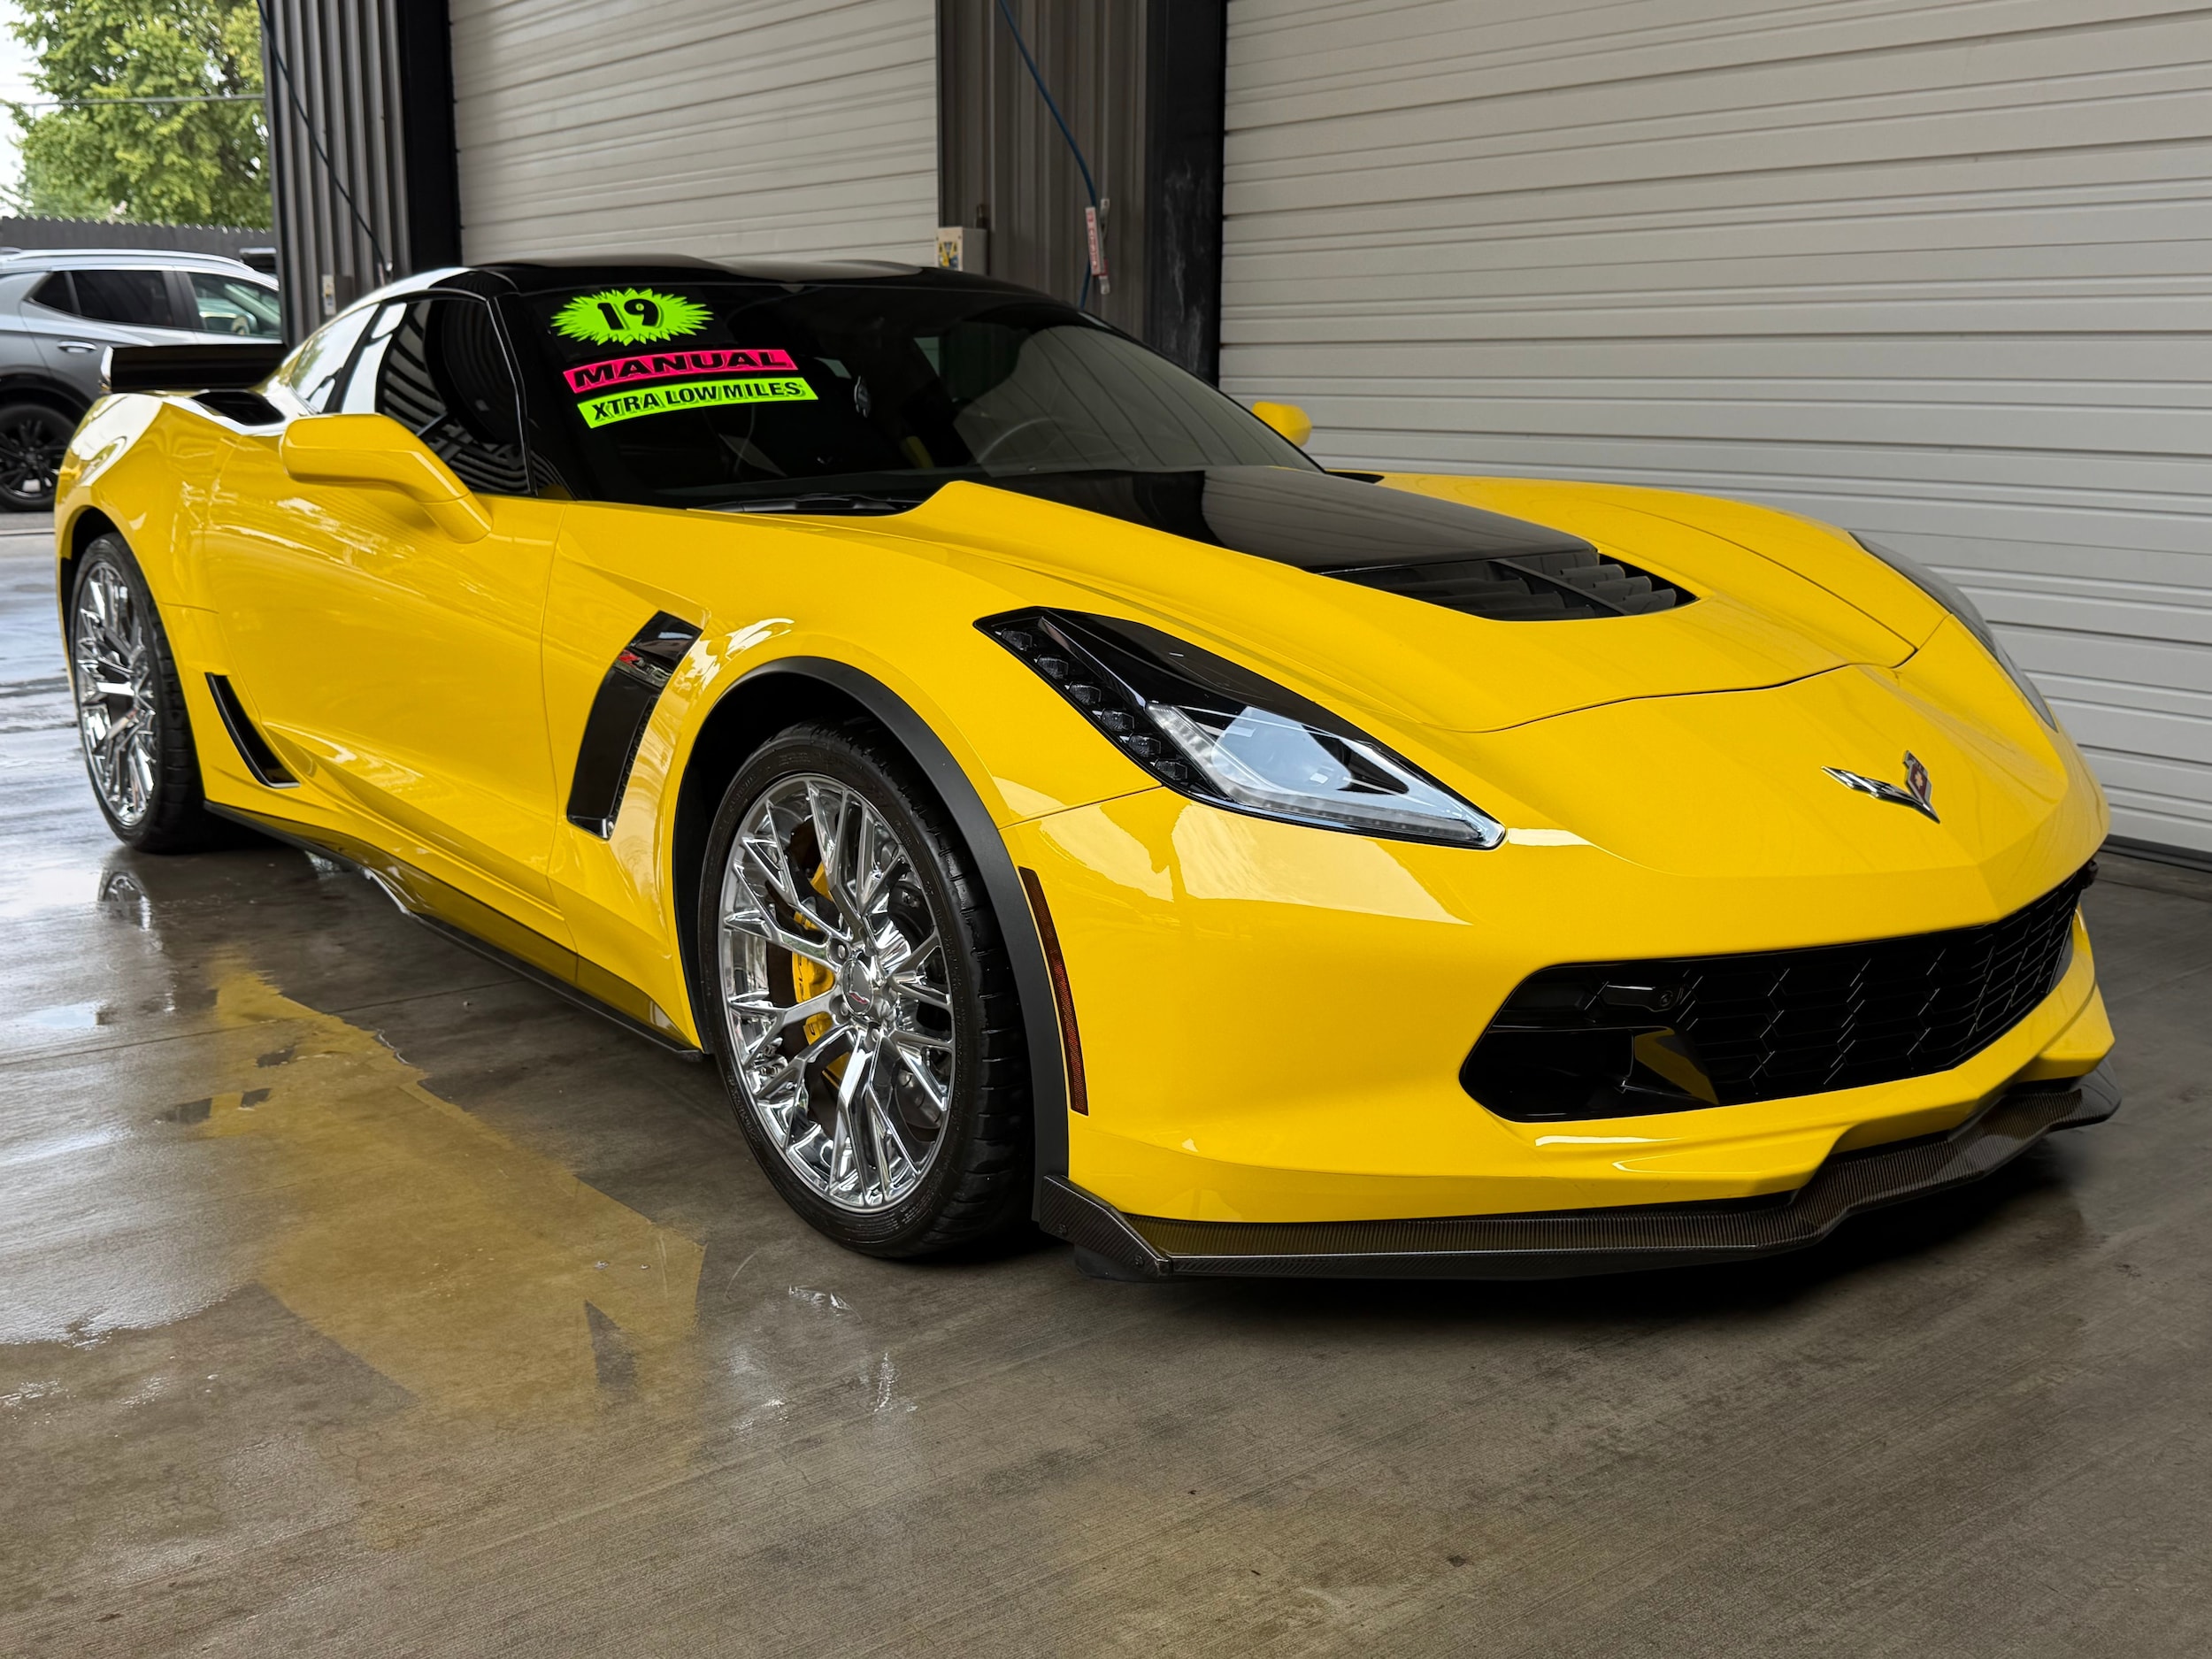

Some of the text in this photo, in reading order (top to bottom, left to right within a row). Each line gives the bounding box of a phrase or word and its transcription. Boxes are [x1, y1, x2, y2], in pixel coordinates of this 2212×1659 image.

[597, 298, 662, 330] 19
[573, 351, 787, 388] MANUAL
[591, 381, 803, 421] XTRA LOW MILES
